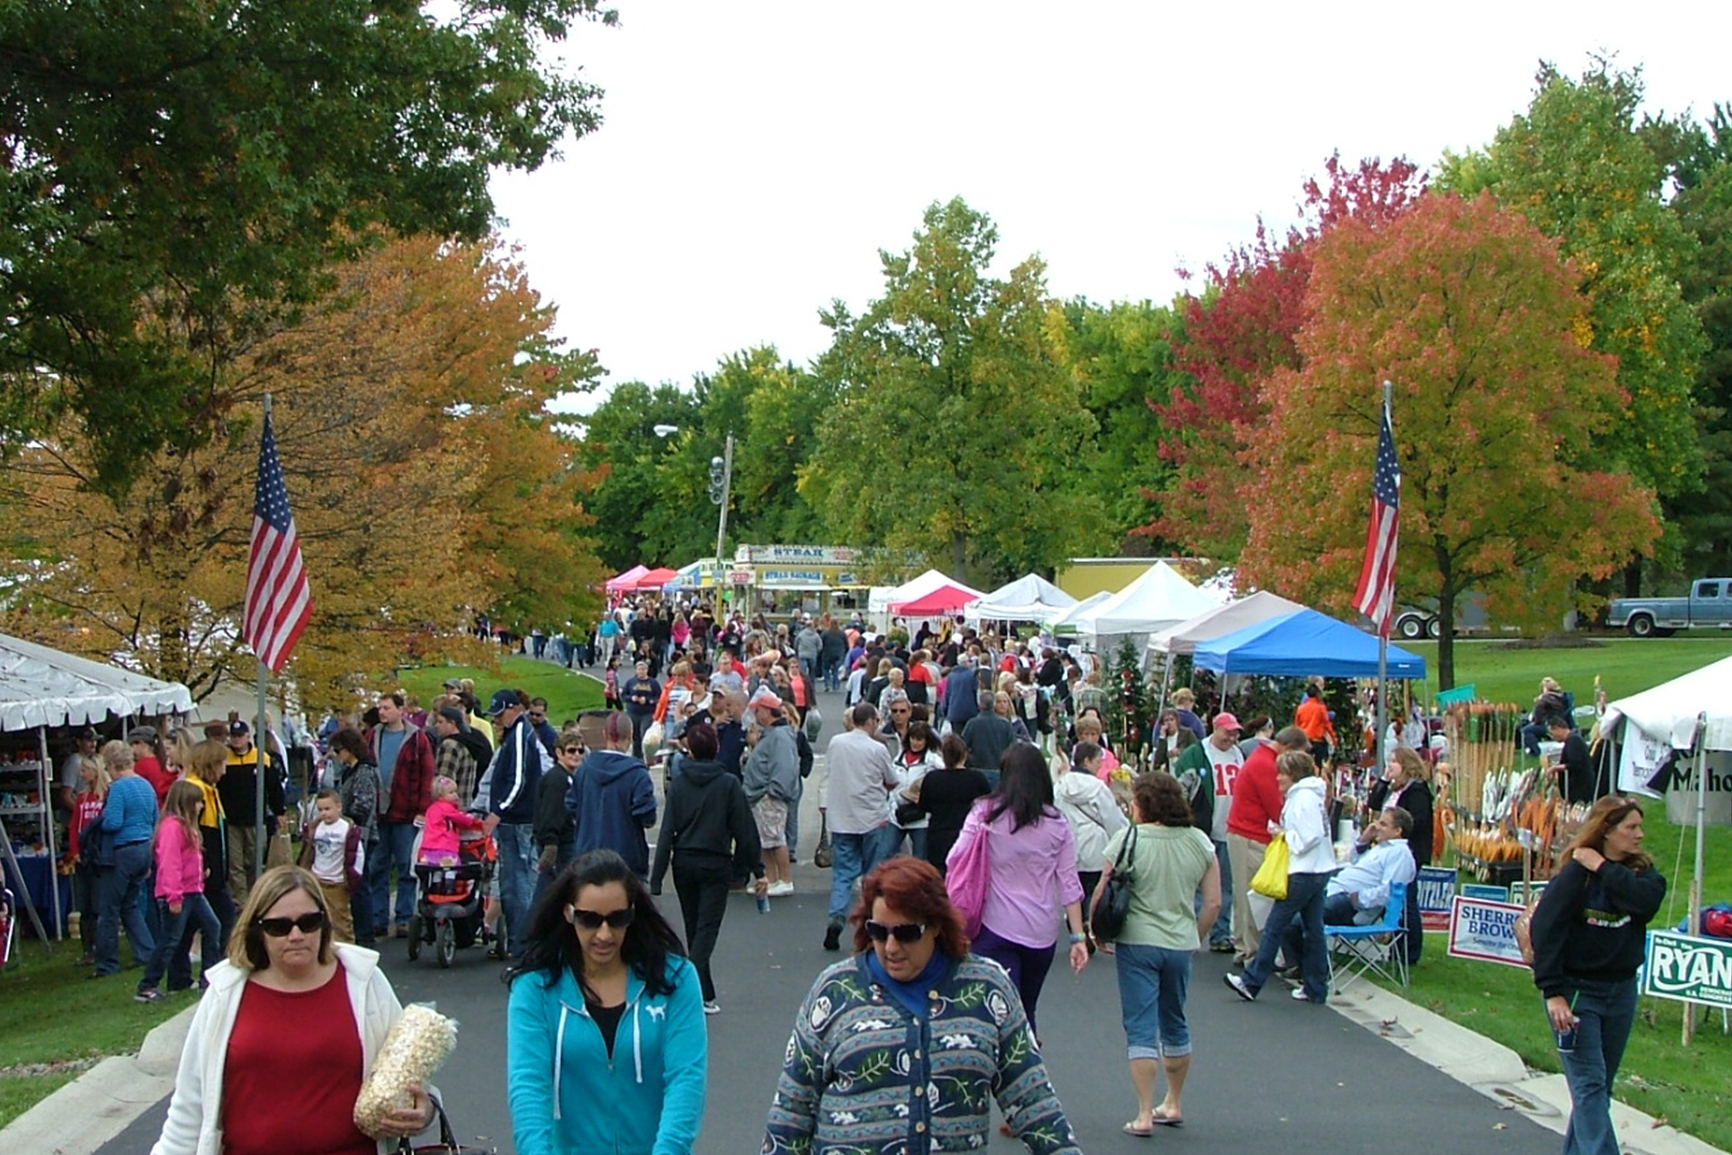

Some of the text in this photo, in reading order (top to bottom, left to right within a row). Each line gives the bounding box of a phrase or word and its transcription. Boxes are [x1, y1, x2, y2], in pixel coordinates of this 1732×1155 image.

[774, 548, 824, 557] STEAK
[1468, 921, 1515, 939] BROW
[1652, 945, 1732, 989] RYAN
